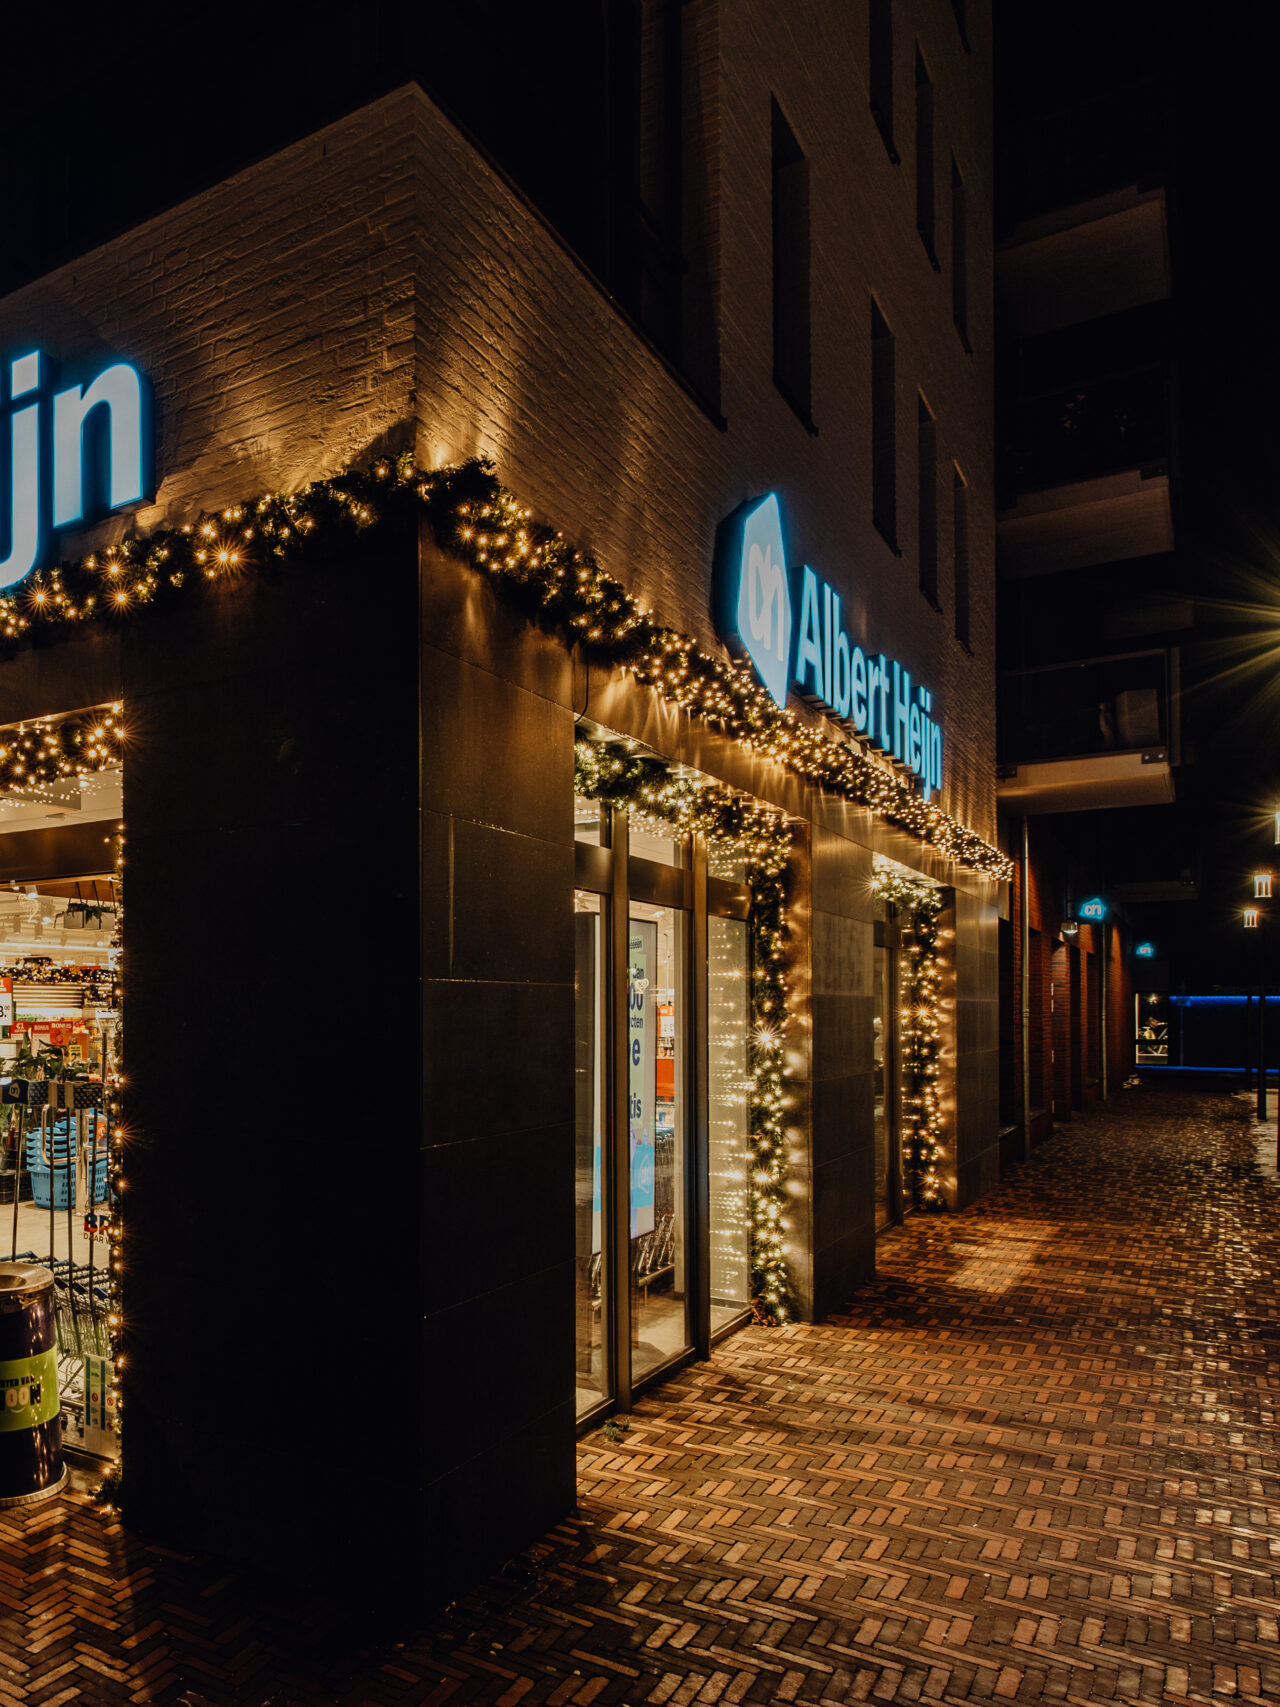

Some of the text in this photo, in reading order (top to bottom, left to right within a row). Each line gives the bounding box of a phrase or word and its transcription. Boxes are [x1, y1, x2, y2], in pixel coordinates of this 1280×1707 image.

[796, 564, 942, 801] Albert Heijn
[83, 1232, 104, 1244] DAR
